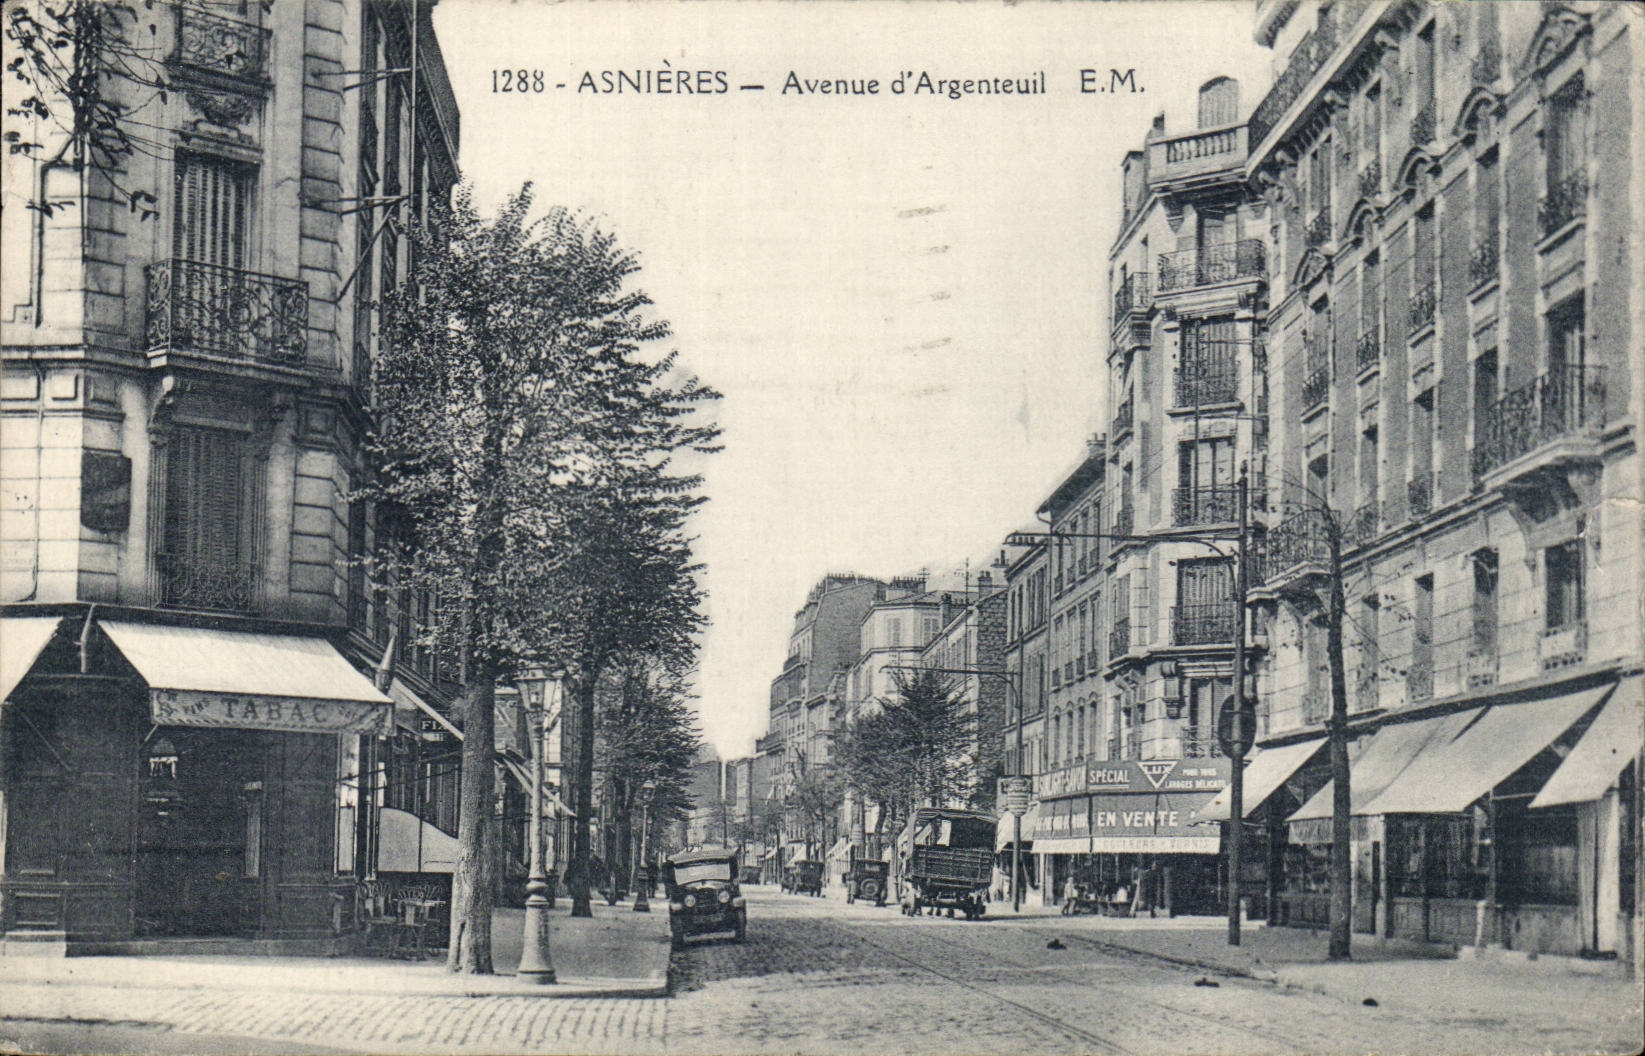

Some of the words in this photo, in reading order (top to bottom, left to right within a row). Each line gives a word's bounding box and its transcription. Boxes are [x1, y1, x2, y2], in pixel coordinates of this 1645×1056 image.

[220, 698, 327, 723] TABAC
[1089, 769, 1130, 783] SPÉCIAL
[1145, 766, 1170, 775] LUX
[1164, 780, 1193, 789] LAVAGES
[1097, 811, 1116, 827] EN
[1122, 811, 1179, 827] VENTE
